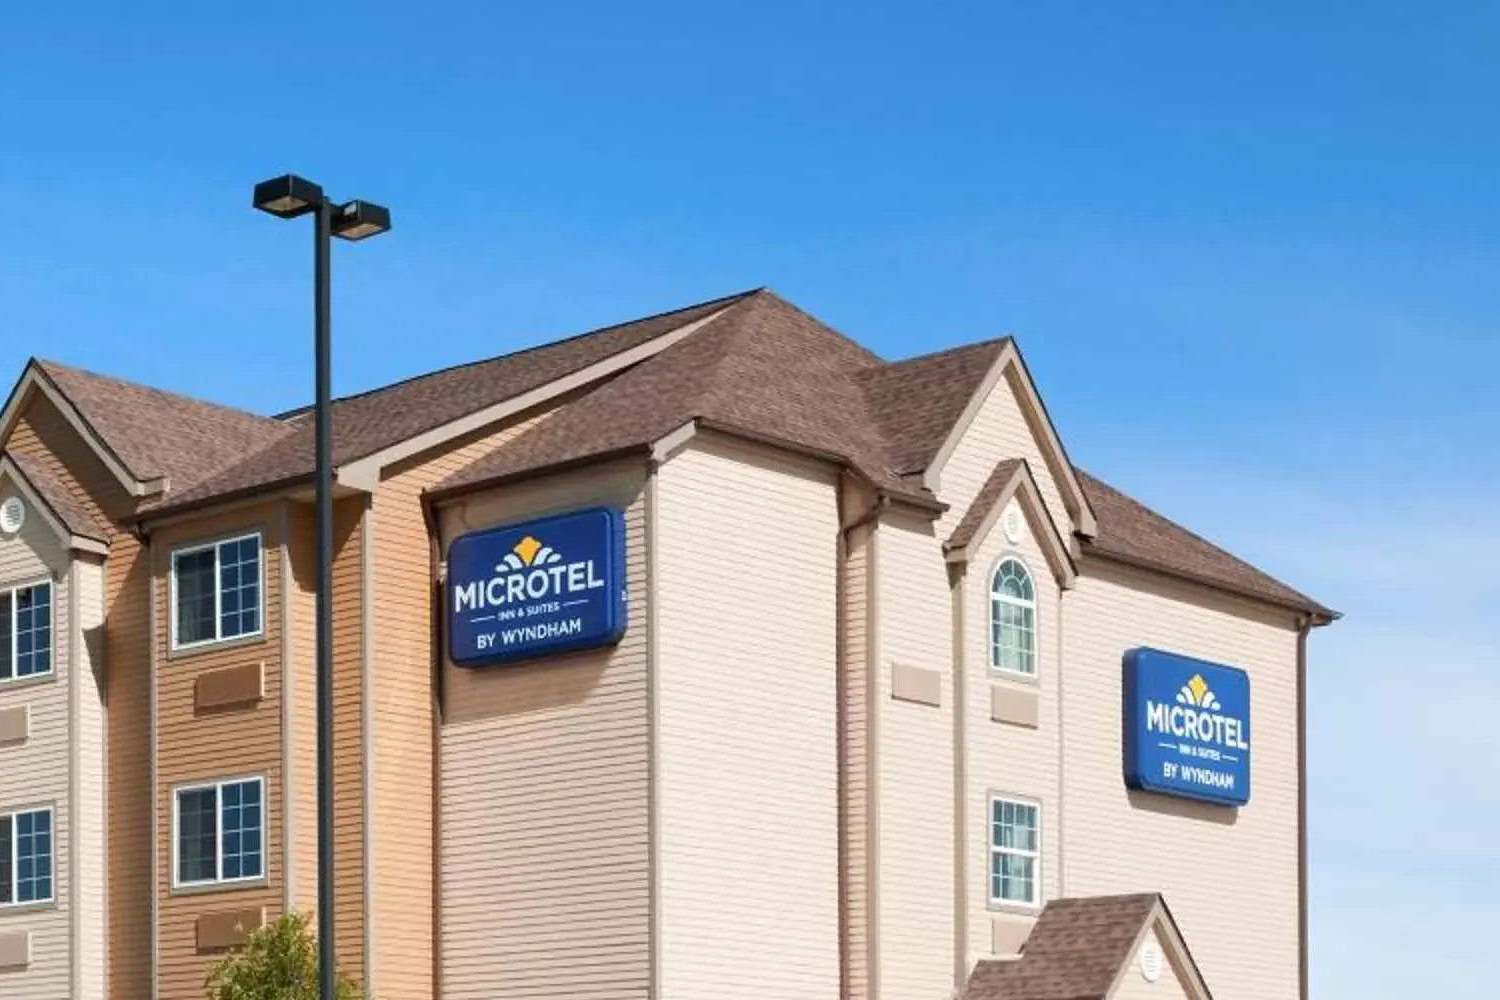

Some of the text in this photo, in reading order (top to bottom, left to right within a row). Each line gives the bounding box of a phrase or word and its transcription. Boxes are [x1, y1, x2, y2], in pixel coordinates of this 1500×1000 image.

[455, 560, 604, 612] MICROTEL
[498, 609, 515, 620] INN
[526, 601, 560, 617] SUITES
[477, 618, 581, 649] BY WYNDHAM
[1147, 700, 1248, 749] MICROTEL
[1163, 761, 1234, 789] BY WYNDHAM
